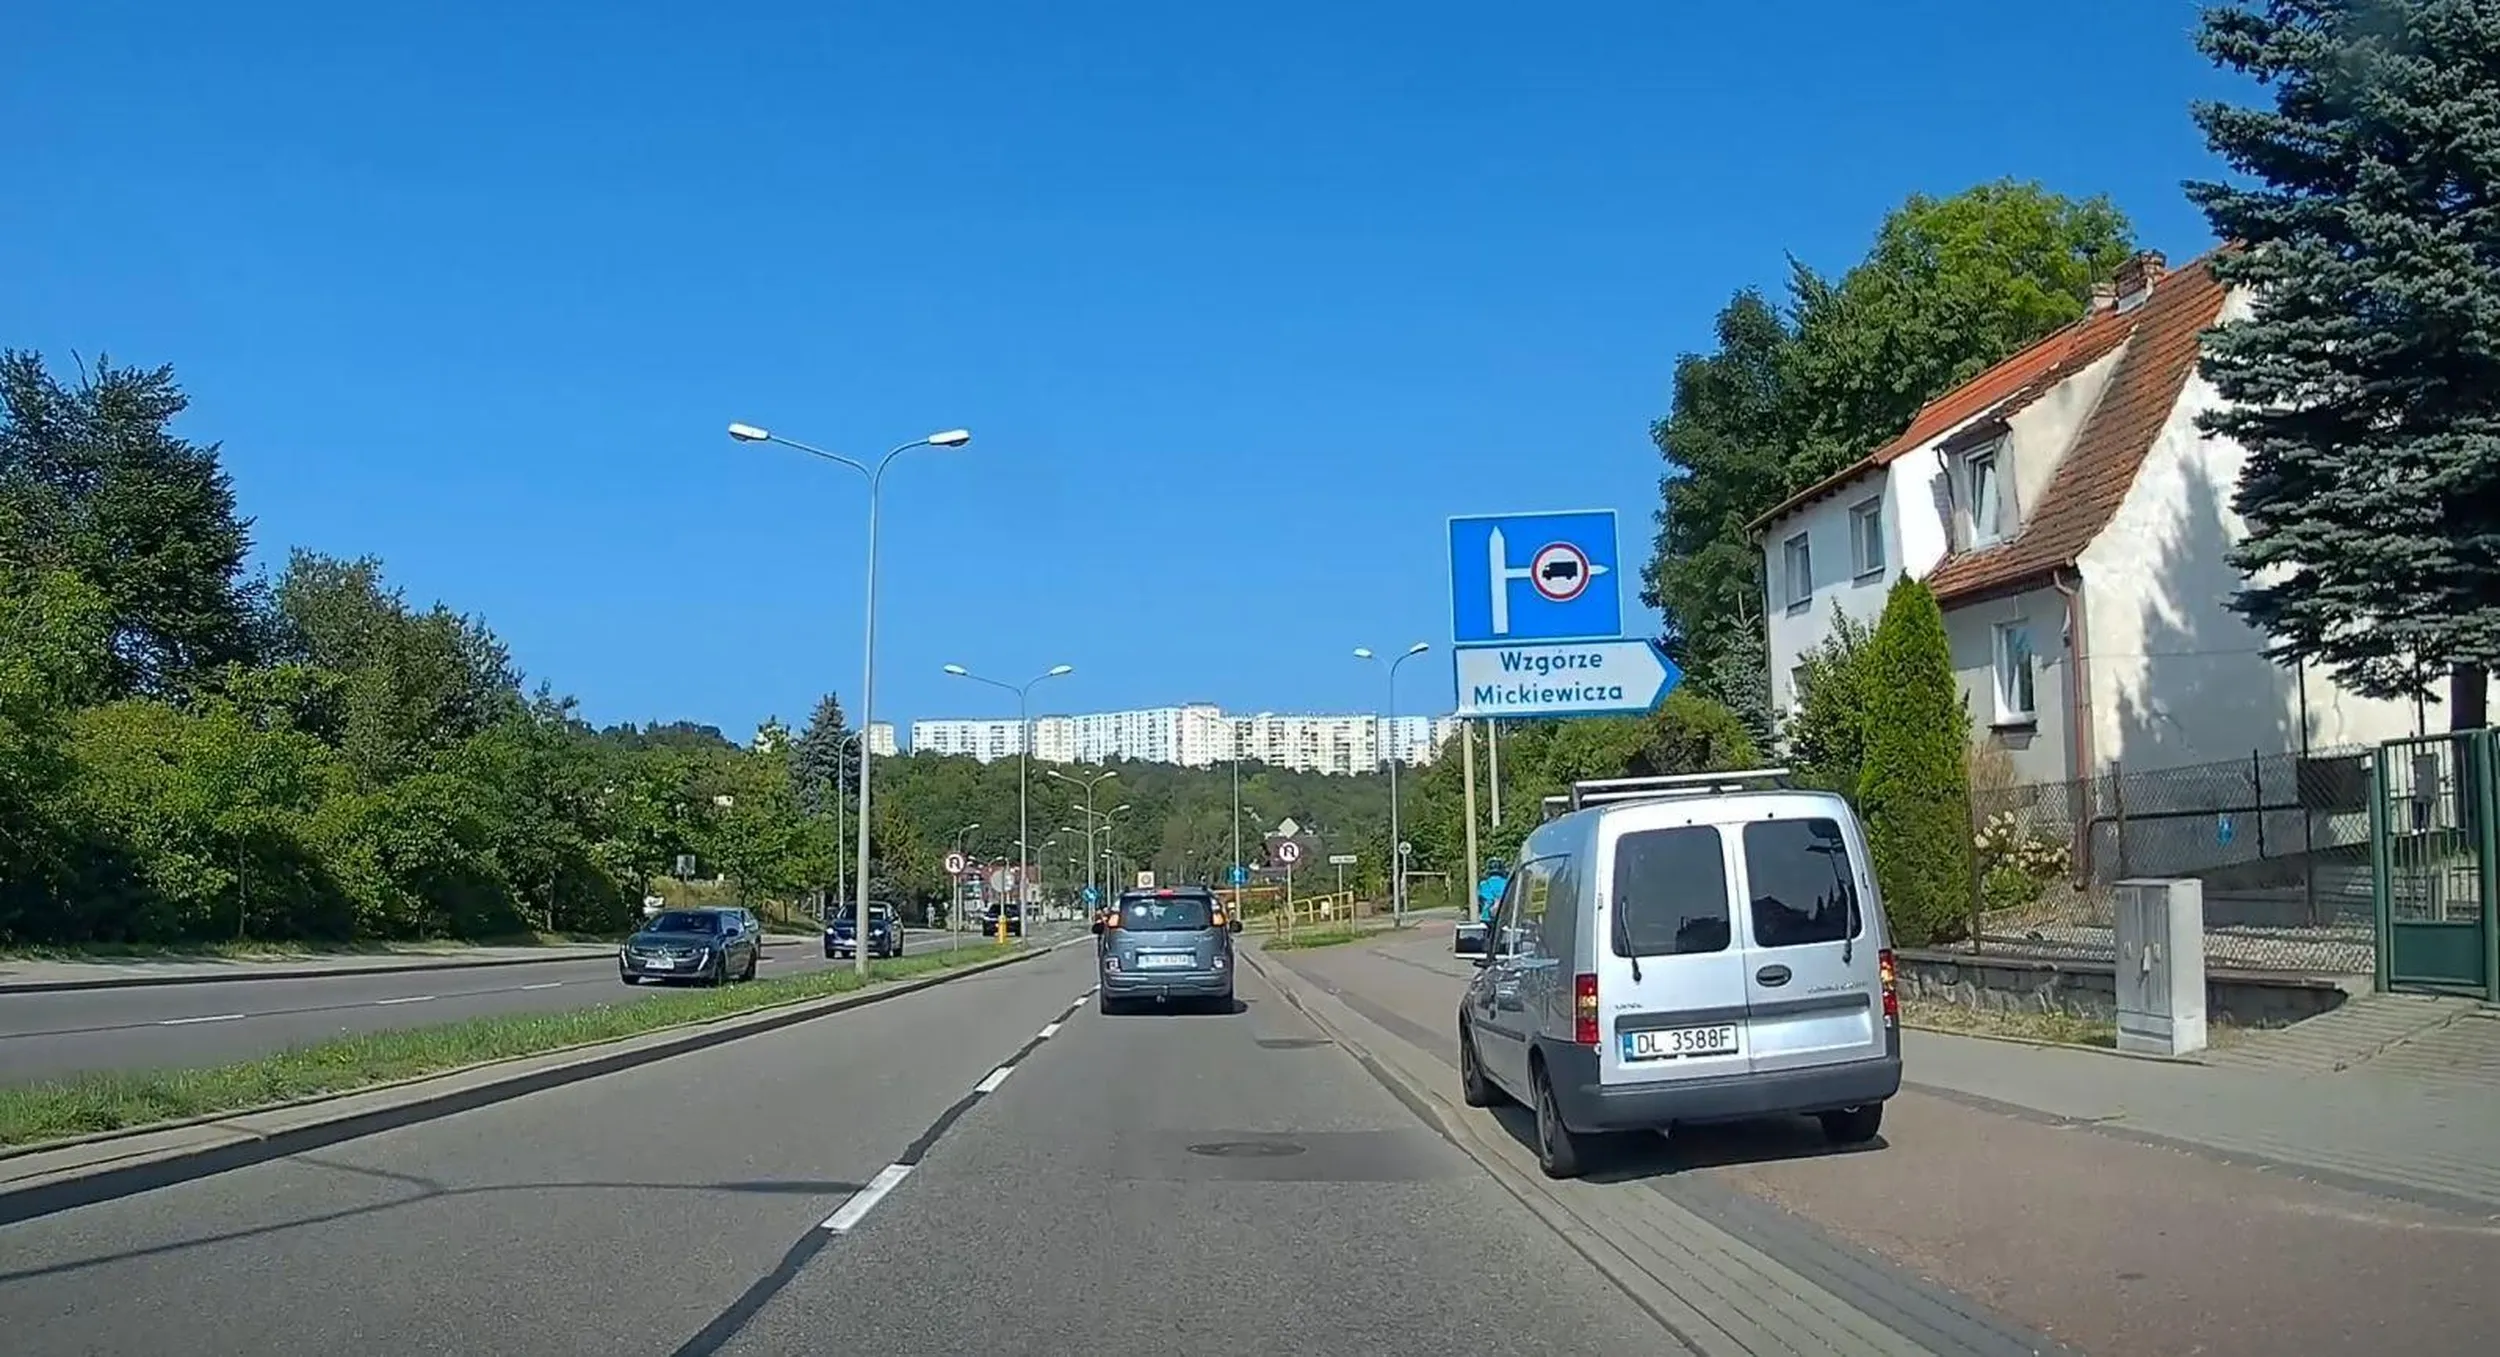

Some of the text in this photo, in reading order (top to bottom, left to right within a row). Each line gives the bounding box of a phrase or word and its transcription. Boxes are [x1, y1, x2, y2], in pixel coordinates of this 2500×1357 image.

[1500, 649, 1602, 676] Wzgórze
[1474, 682, 1623, 706] Mickiewicza
[1638, 1027, 1730, 1053] DL 3588F
